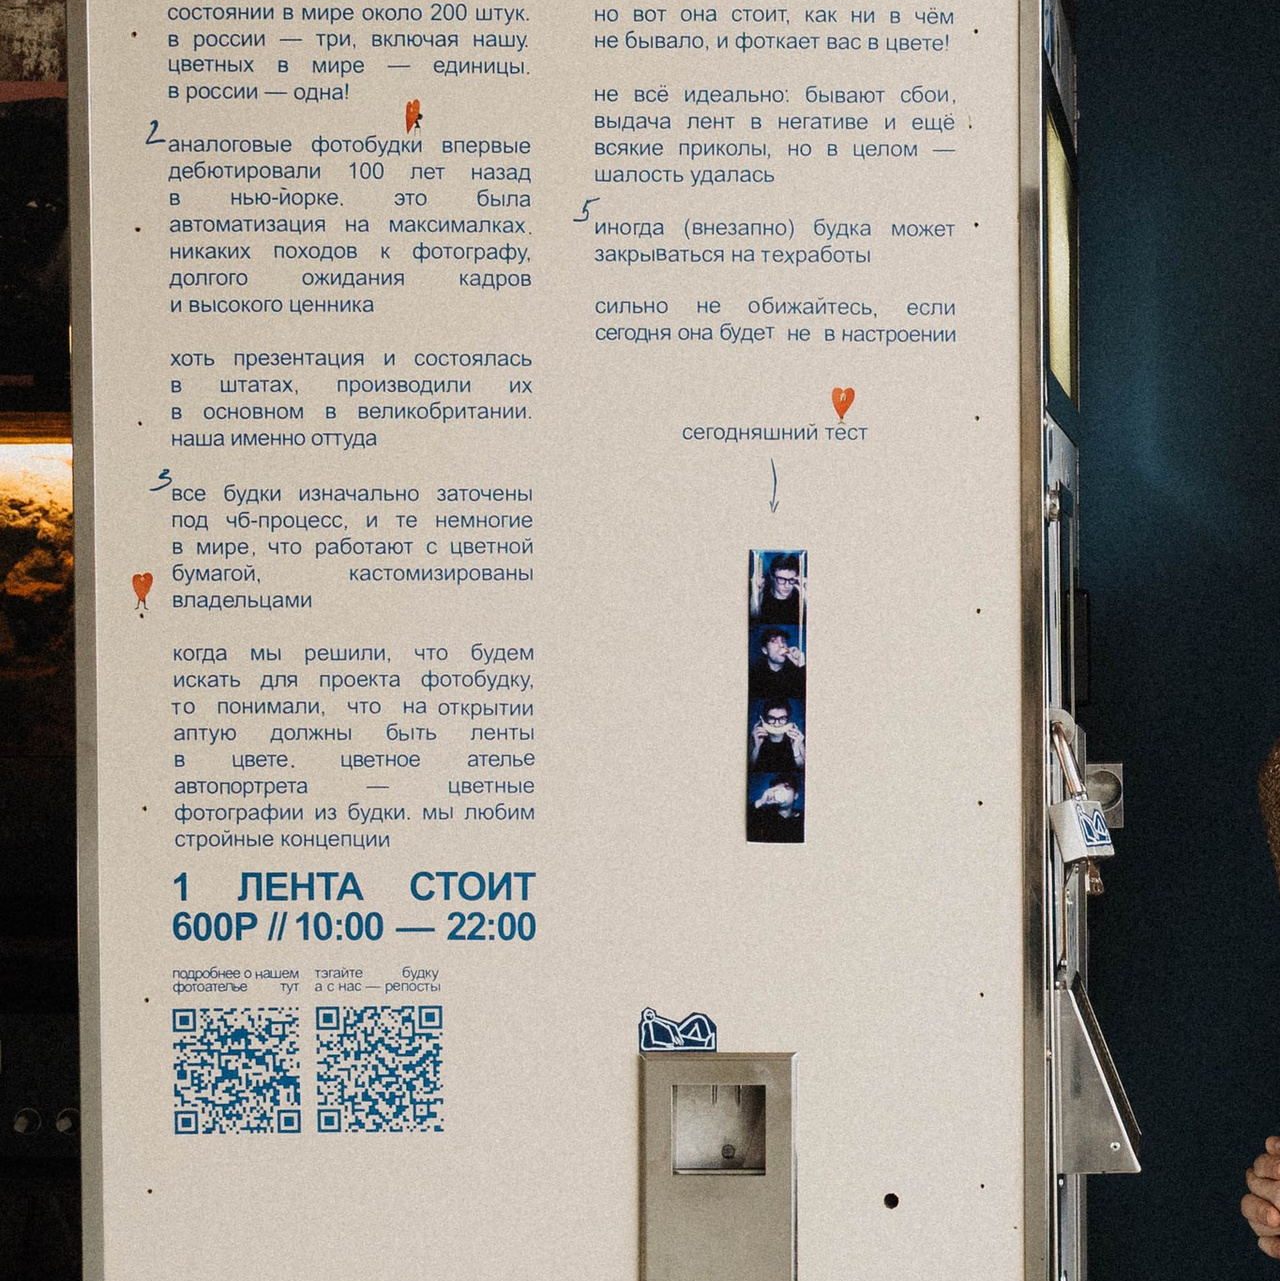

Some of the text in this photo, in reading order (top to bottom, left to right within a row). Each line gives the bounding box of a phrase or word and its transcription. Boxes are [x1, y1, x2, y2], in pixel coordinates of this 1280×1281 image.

[167, 3, 529, 26] состоянии в мире около 200 штук.
[594, 30, 949, 53] не бывало, и фоткает вас в цвете!
[594, 85, 956, 105] не всё идеально: бывают сбои,
[145, 119, 166, 146] 2
[168, 135, 531, 158] аналоговые фотобудки впервые
[168, 160, 531, 184] дебютировали 100 лет назад
[594, 169, 775, 187] шалость удалась
[573, 197, 600, 222] 5
[169, 218, 532, 235] автоматизация на максималках.
[595, 218, 955, 240] иногда (внезапно) будка может
[170, 242, 530, 265] никаких походов к фотографу,
[594, 245, 871, 267] закрываться на техработы
[169, 272, 532, 291] долгого ожидания кадров
[595, 296, 955, 318] сильно не обижайтесь, если
[595, 323, 956, 346] сегодня она будет не в настроении
[170, 352, 532, 370] хоть презентация и состоялась
[171, 379, 532, 397] в штатах, производили их
[171, 432, 377, 451] наша именно оттуда
[682, 423, 868, 443] сегодняшний тест
[149, 468, 173, 491] 3
[172, 484, 532, 506] все будки изначально заточены
[172, 563, 533, 586] бумагой, кастомизированы
[172, 595, 312, 611] владельцами
[173, 643, 534, 665] когда мы решили, что будем
[173, 669, 533, 692] искать для проекта фотобудку,
[173, 723, 534, 746] аптую должны быть ленты
[174, 802, 535, 825] фотографии из будки. мы любим
[174, 830, 390, 851] стройные концепции
[173, 871, 536, 901] 1 ЛЕНТА СТОИТ
[172, 911, 258, 942] 600Р
[296, 911, 384, 941] 10:00
[447, 911, 536, 941] 22:00
[172, 966, 241, 982] подробнее
[255, 969, 299, 979] нашем
[315, 966, 439, 981] тэгайте будку
[172, 981, 299, 995] фотоателье тут
[338, 982, 361, 992] нас
[385, 982, 440, 994] репосты
